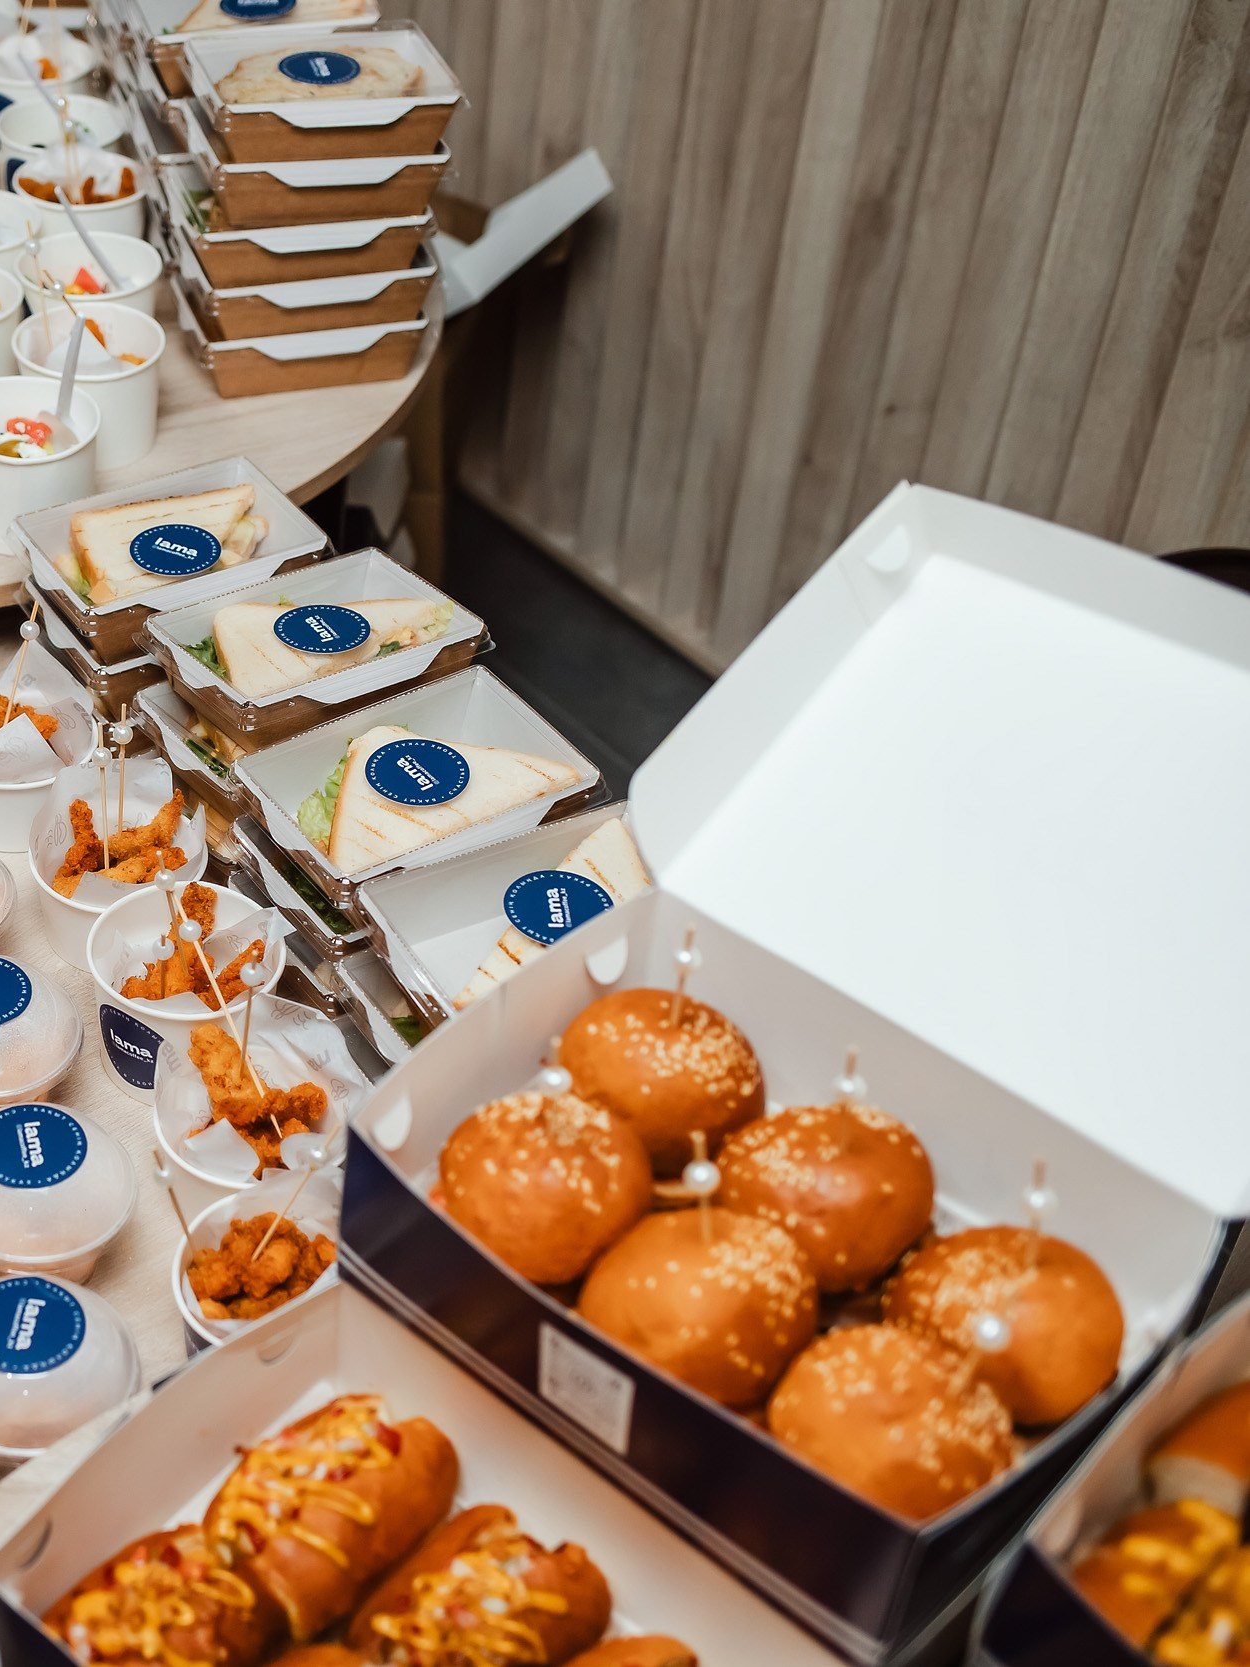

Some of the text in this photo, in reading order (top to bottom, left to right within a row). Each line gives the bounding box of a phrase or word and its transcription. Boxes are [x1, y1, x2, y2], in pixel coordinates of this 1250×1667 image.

[154, 537, 198, 557] lama
[305, 616, 334, 643] lama
[396, 757, 434, 791] lama
[546, 888, 564, 928] lama
[110, 1028, 153, 1059] lama
[132, 1078, 153, 1086] ТВОИ
[23, 1121, 44, 1168] lama
[15, 1298, 46, 1351] lama
